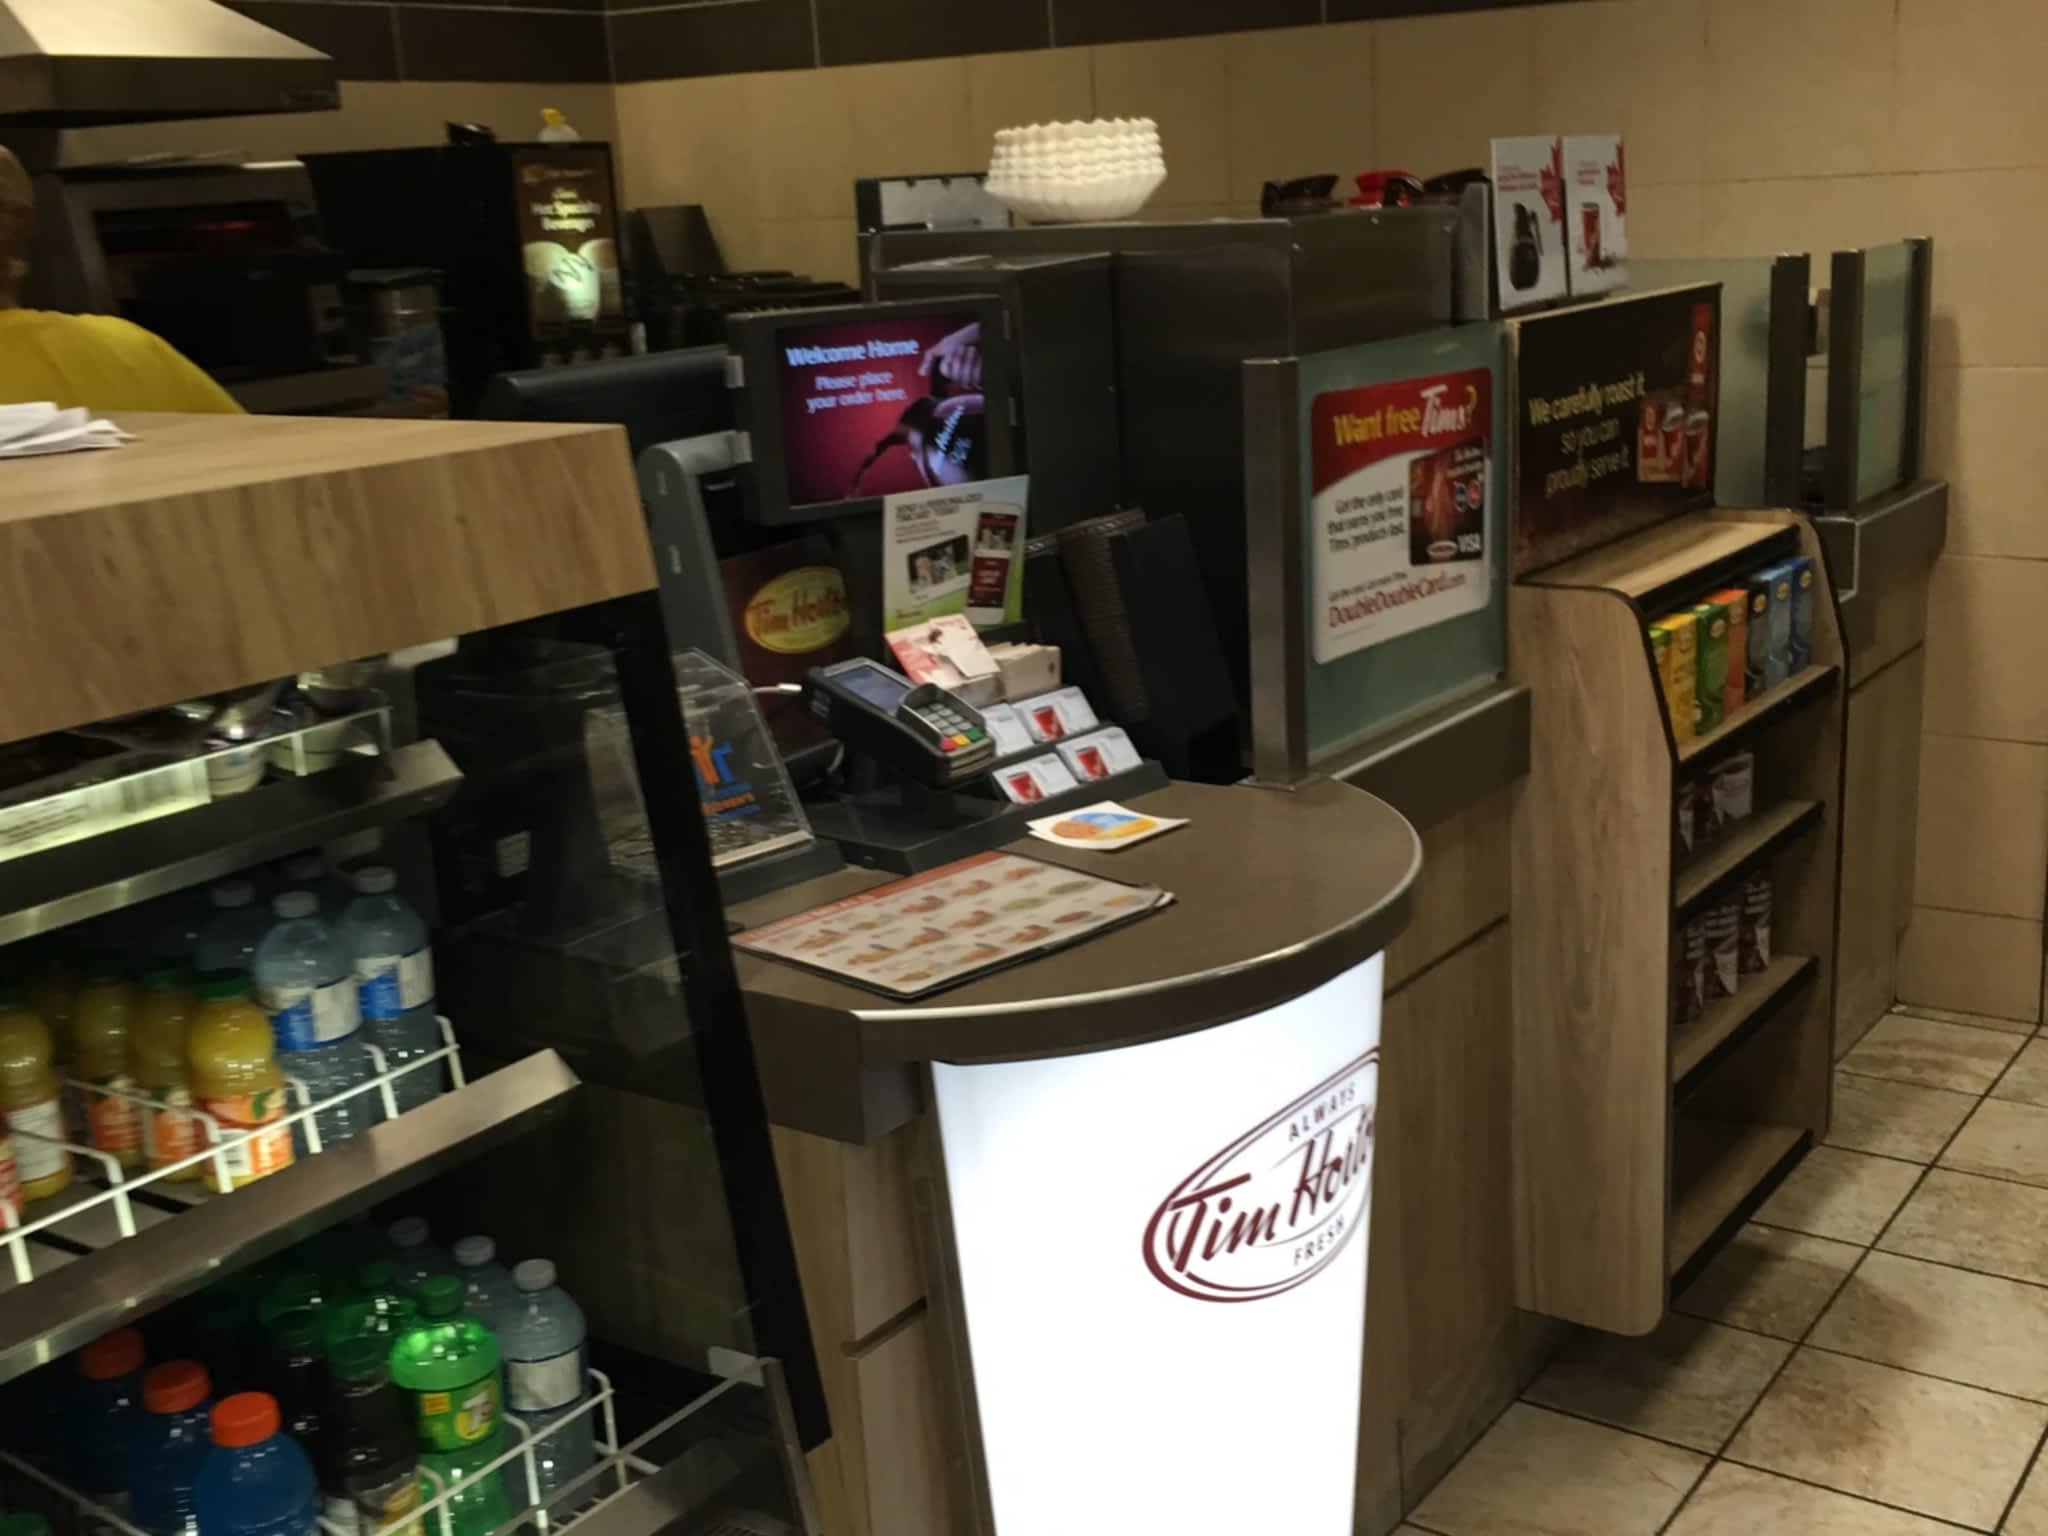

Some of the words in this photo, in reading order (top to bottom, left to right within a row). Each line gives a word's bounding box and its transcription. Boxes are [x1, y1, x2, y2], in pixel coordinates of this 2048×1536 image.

[785, 342, 866, 367] Welcome
[866, 338, 919, 359] Home
[805, 395, 837, 414] your
[839, 391, 873, 407] order
[815, 374, 856, 391] Please
[858, 371, 894, 390] place
[1527, 397, 1551, 427] We
[1551, 382, 1603, 420] carefully
[1603, 373, 1635, 406] roast
[1333, 412, 1383, 447] Want
[1385, 403, 1420, 434] free
[1560, 429, 1576, 456] so
[1576, 425, 1598, 460] you
[1599, 416, 1621, 443] can
[1544, 463, 1588, 500] proudly
[1328, 572, 1467, 628] DoubleDoubleCard.com
[1289, 1081, 1357, 1142] ALWAYS
[1166, 1172, 1281, 1274] Tim
[1293, 1215, 1345, 1267] FRESH
